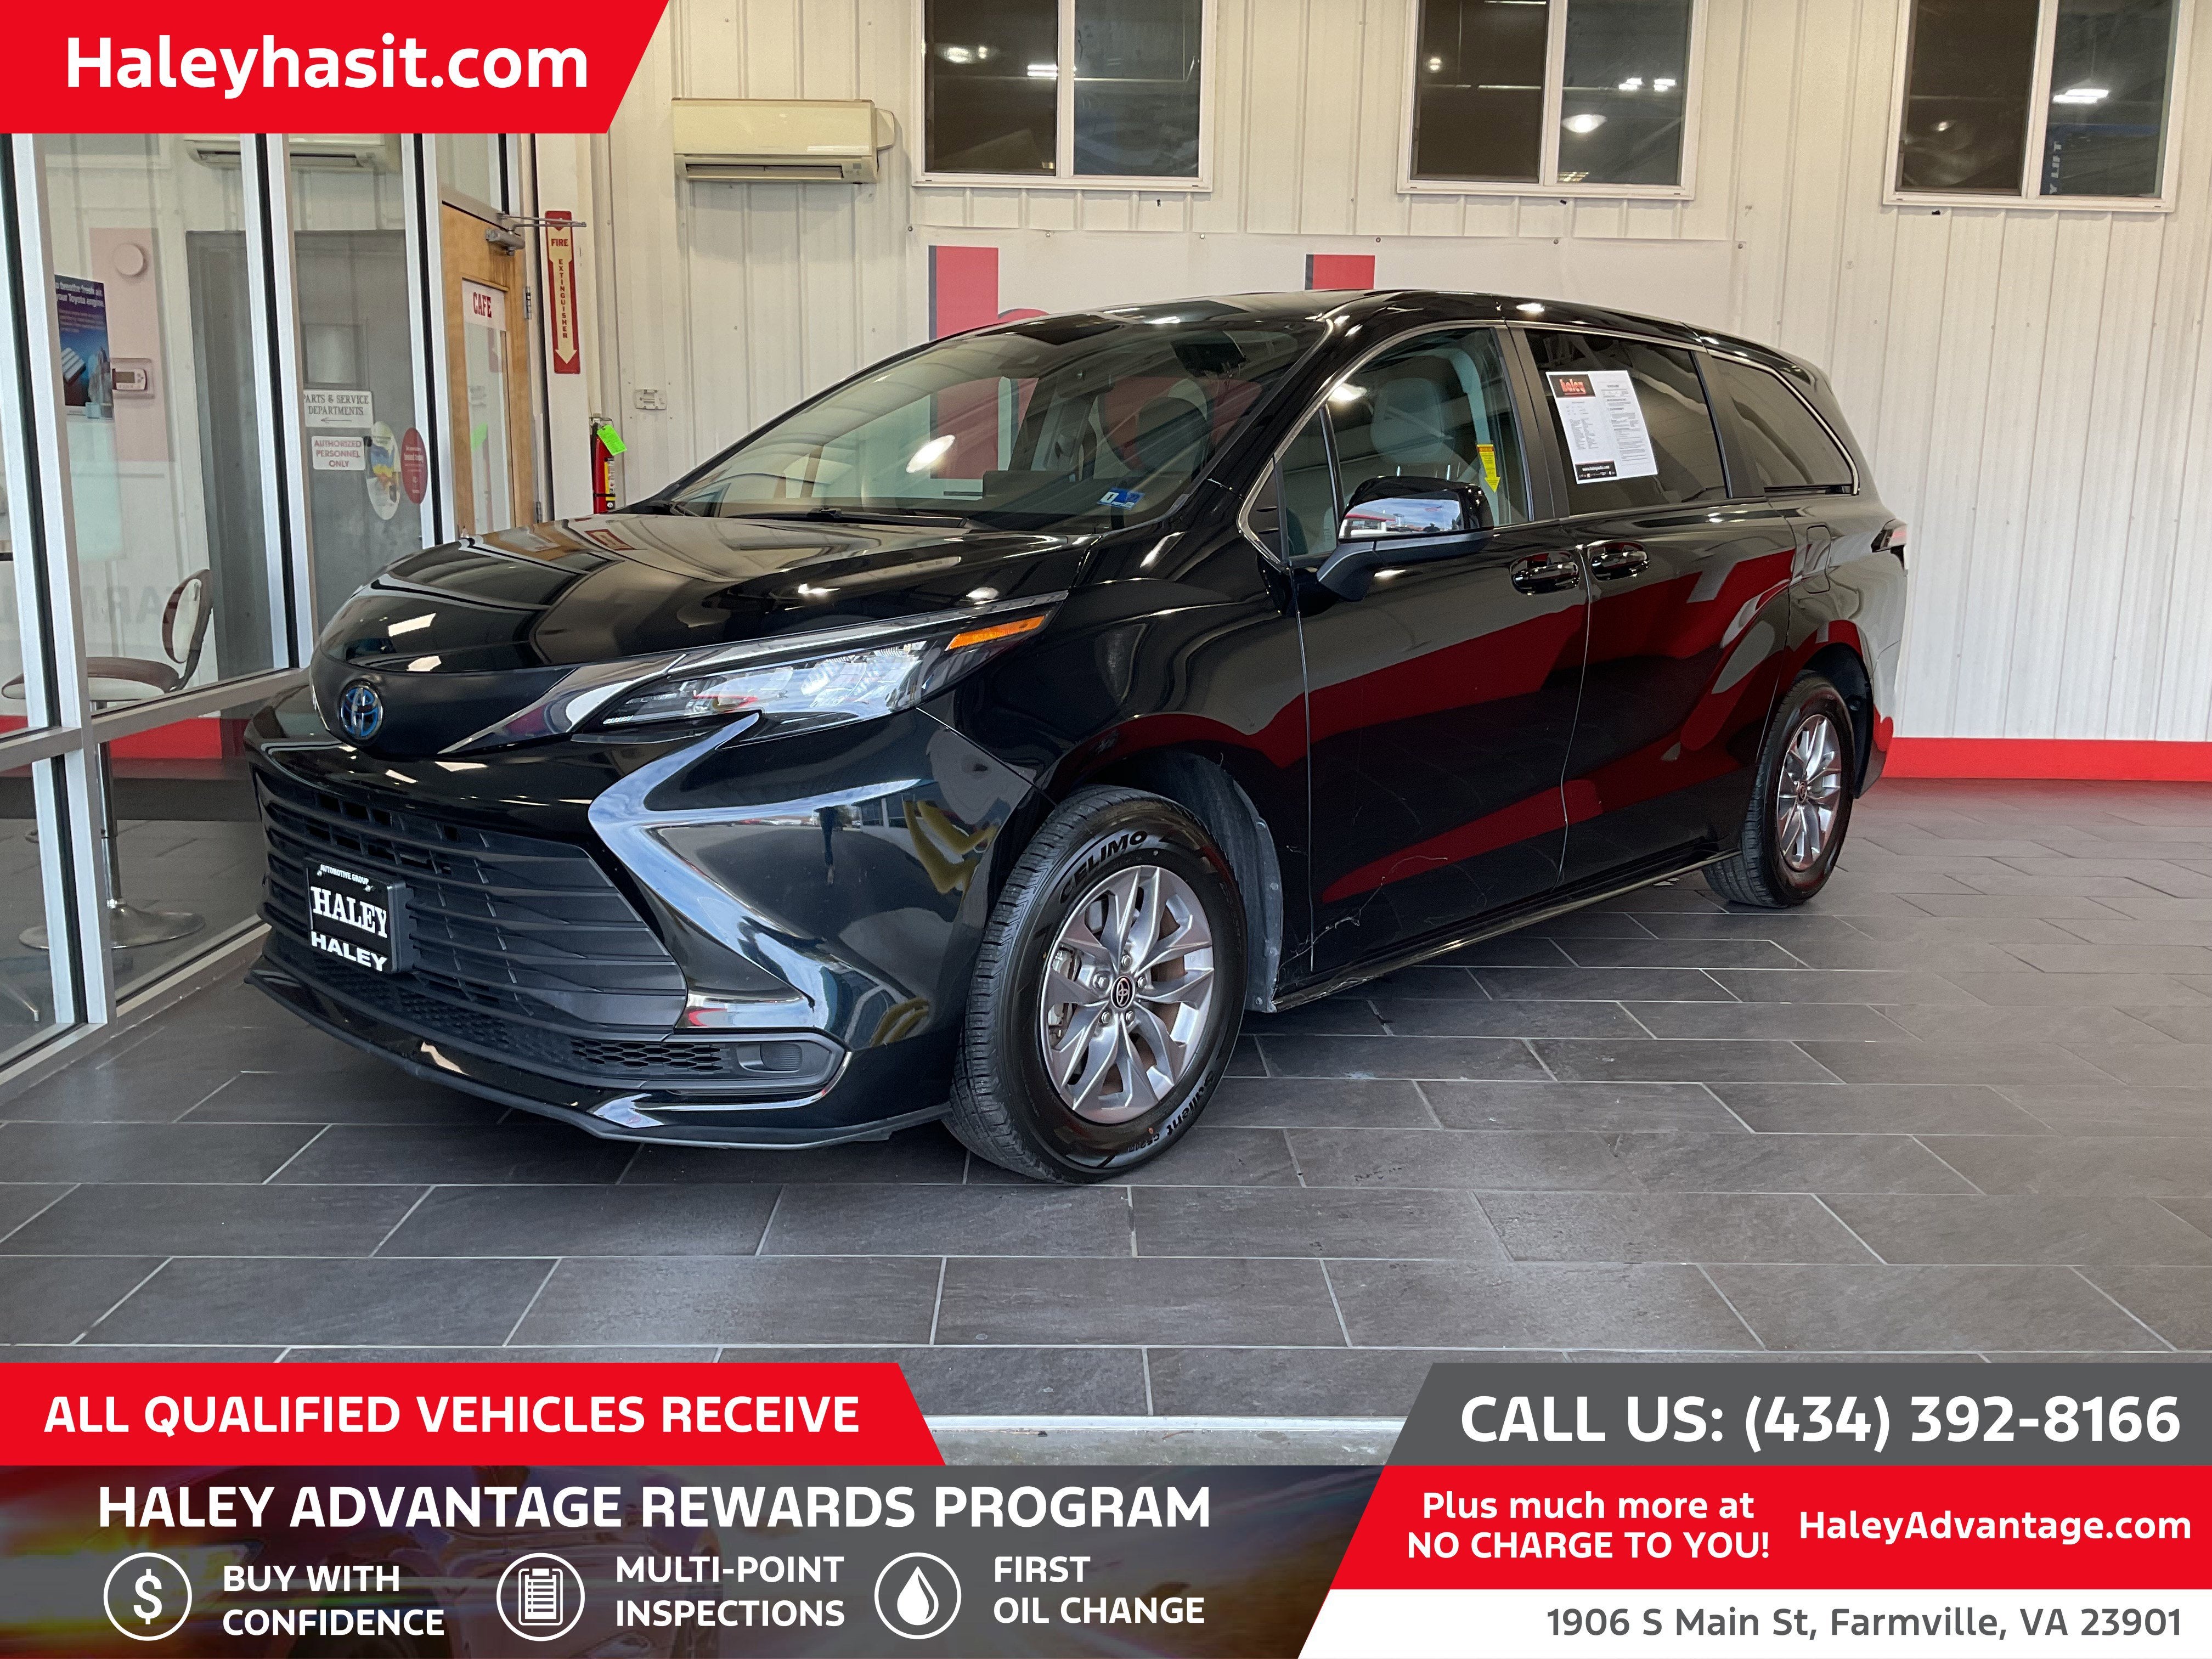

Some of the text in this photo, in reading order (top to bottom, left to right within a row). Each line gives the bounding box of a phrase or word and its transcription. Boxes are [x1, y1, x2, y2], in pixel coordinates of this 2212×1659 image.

[551, 238, 569, 247] FIRE
[473, 291, 492, 318] CAFE
[558, 258, 568, 338] EXTINGUISHER
[329, 394, 334, 404] &
[336, 395, 370, 404] SERVICE
[308, 405, 364, 416] DEPARTMENTS
[314, 439, 362, 448] AUTHORIZED
[316, 450, 361, 458] PERSONNEL
[320, 864, 370, 885] AUTOMOTIVE GROUP
[1059, 830, 1148, 904] CELIMO
[310, 885, 388, 939] HALEY
[311, 930, 388, 972] HALEY
